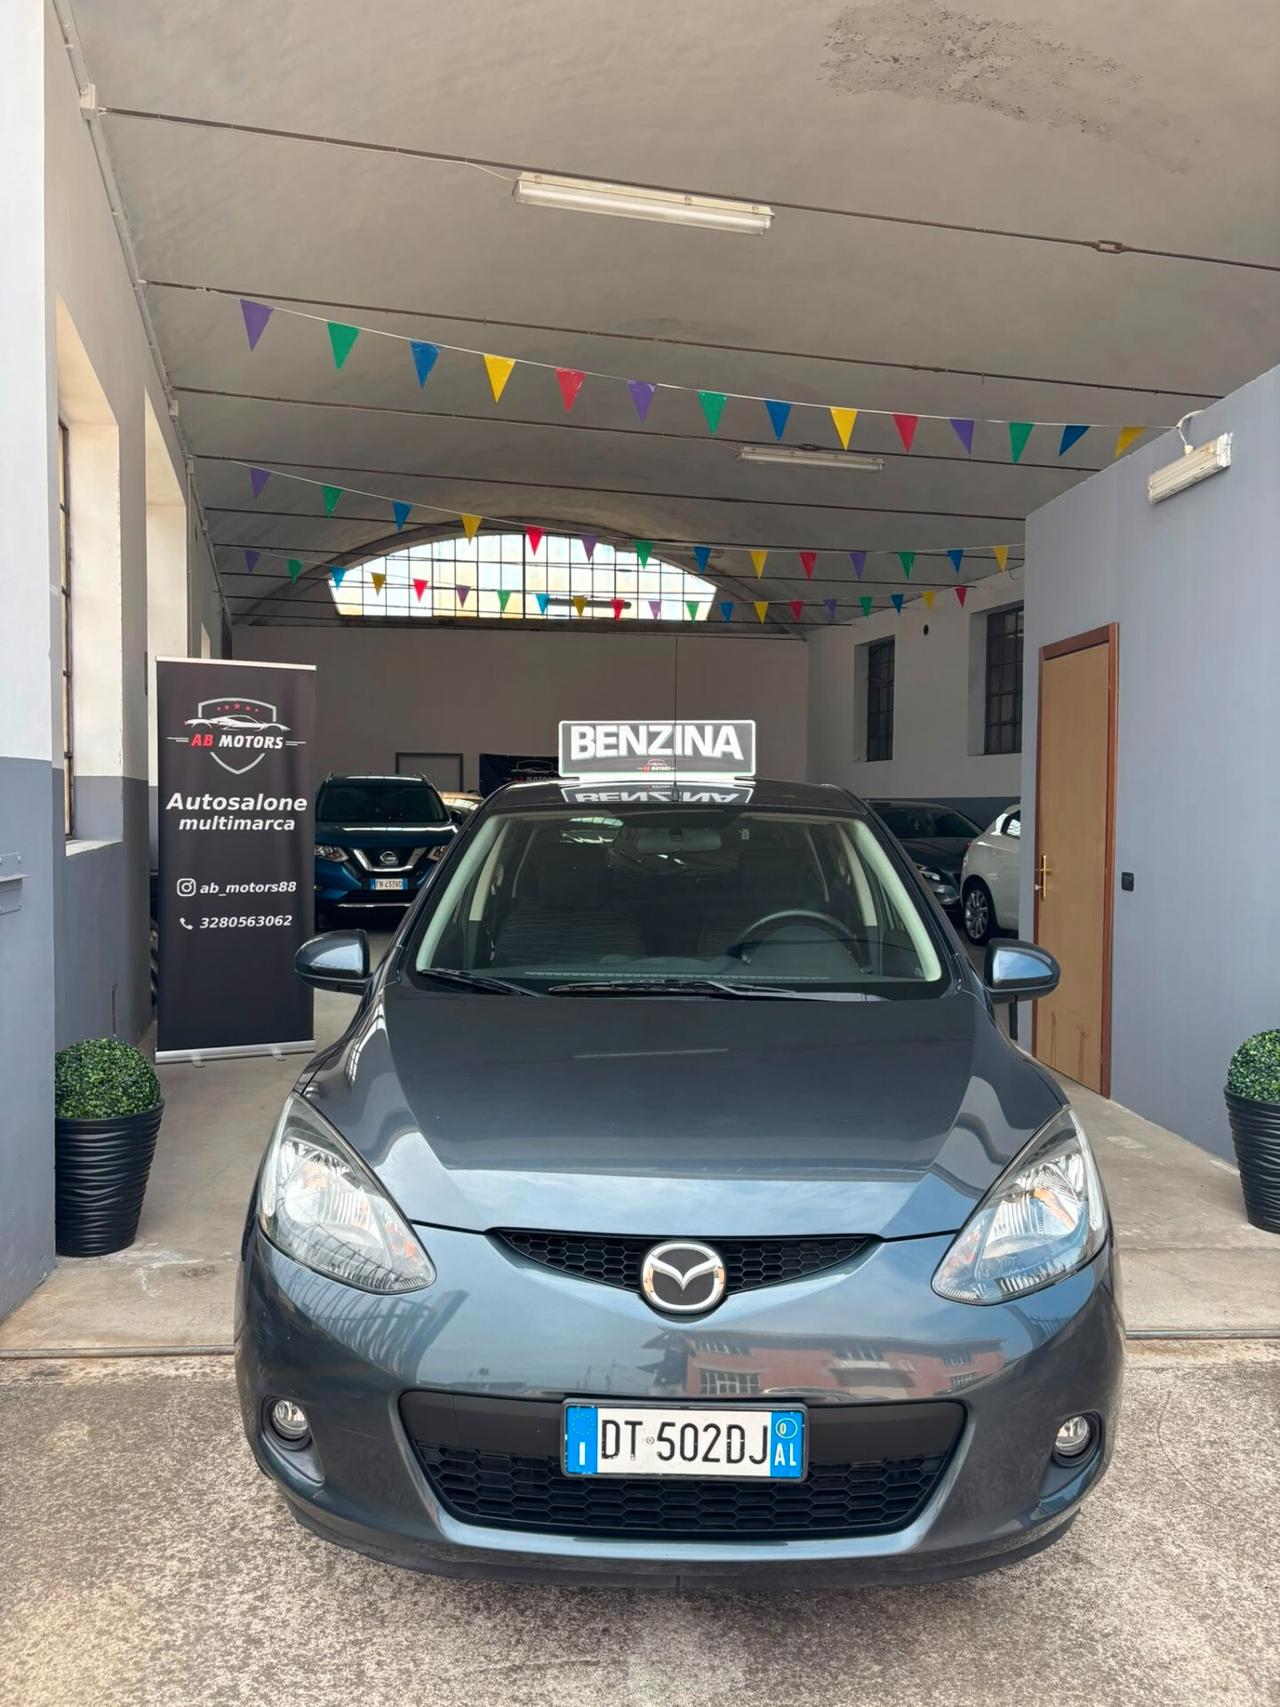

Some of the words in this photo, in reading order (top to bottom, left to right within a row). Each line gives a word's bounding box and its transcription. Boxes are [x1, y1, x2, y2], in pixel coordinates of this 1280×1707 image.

[191, 734, 214, 747] AB
[218, 735, 284, 749] MOTORS
[570, 724, 745, 760] BENZINA
[166, 792, 308, 811] Autosalone
[179, 816, 295, 831] multimarca
[200, 881, 297, 896] ab_motors88
[200, 915, 293, 929] 3280563062
[601, 1419, 643, 1461] DT
[656, 1422, 768, 1465] 502DJ
[774, 1442, 797, 1466] AL
